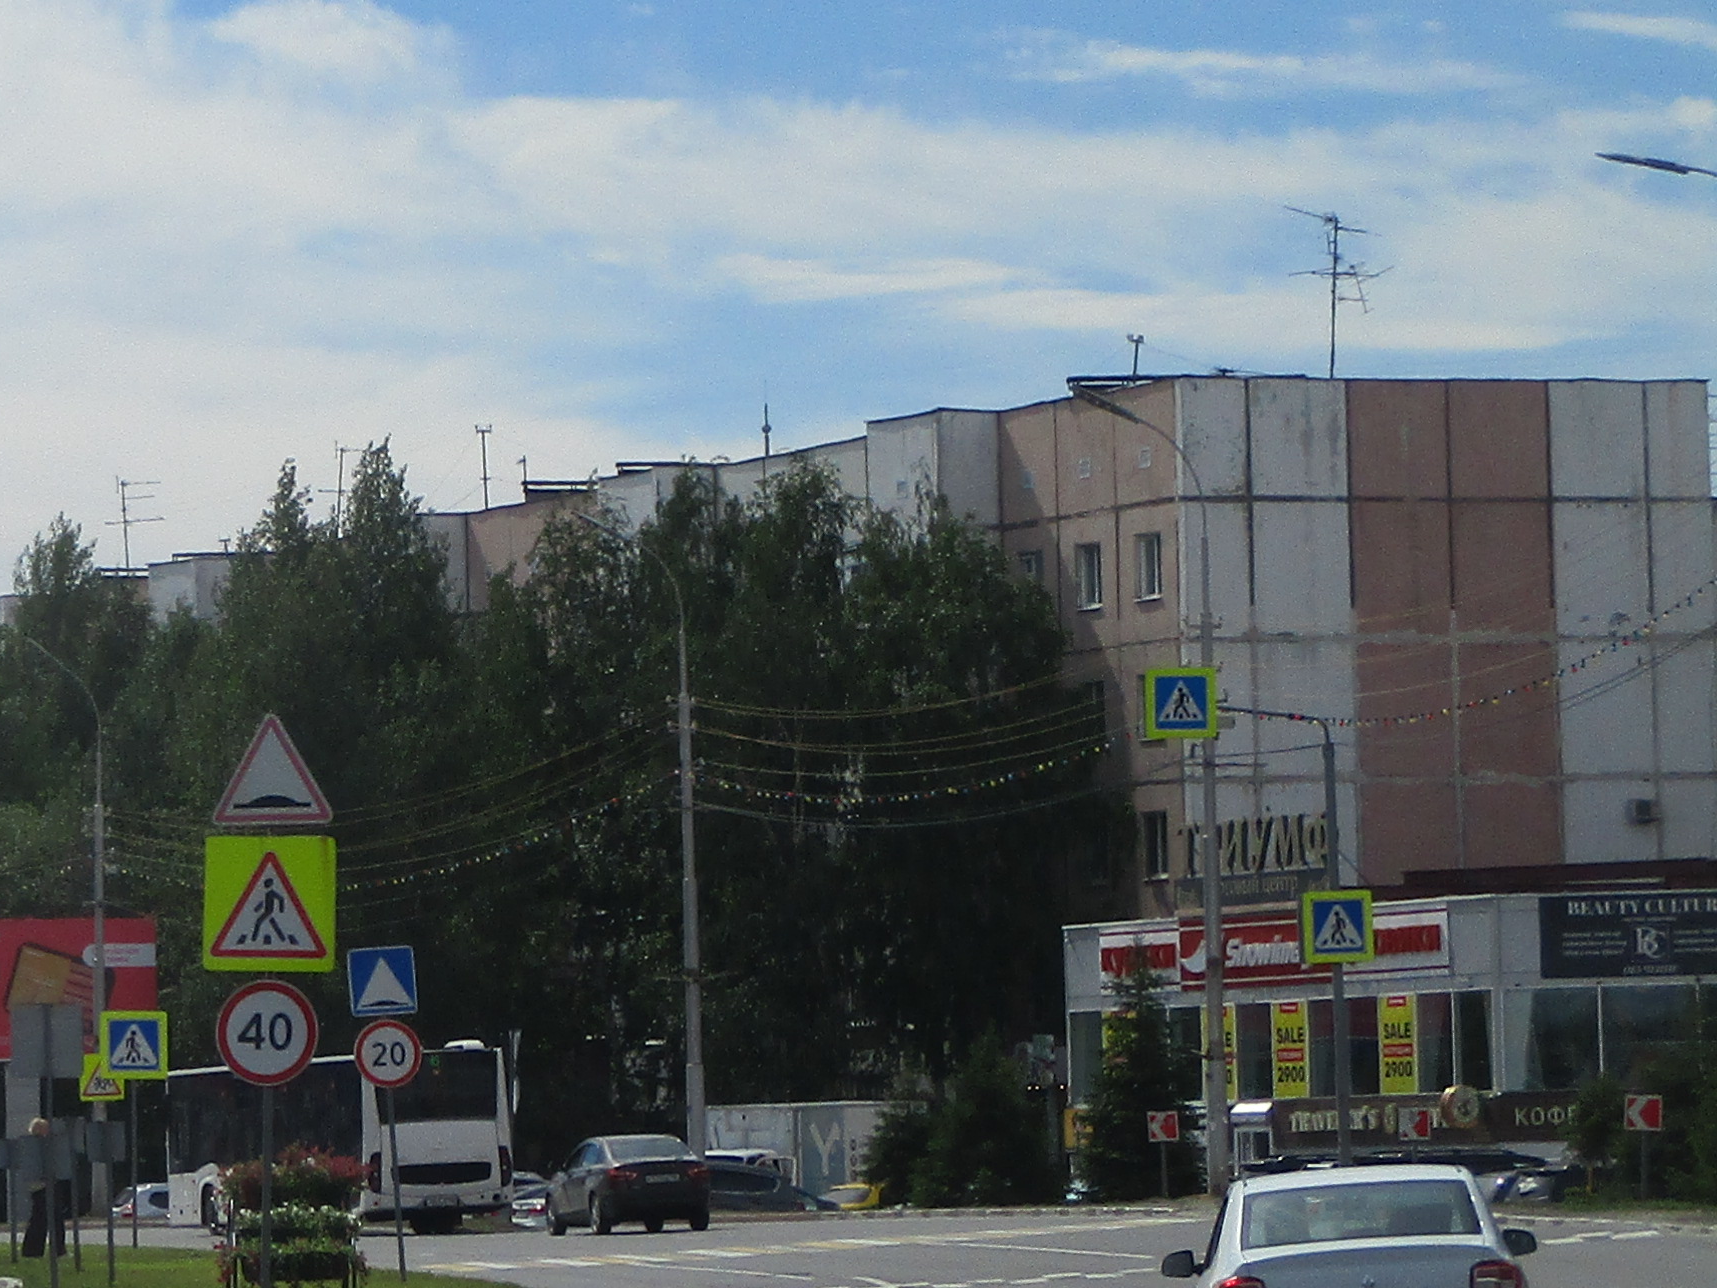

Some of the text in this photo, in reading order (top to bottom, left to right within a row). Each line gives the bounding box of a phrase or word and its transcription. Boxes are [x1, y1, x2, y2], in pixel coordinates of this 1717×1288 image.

[1176, 813, 1331, 880] ТИУМФ
[1567, 899, 1641, 915] BEAUTY
[237, 1011, 293, 1052] 40
[1276, 1026, 1306, 1044] SALE
[1383, 1022, 1412, 1040] SALE
[371, 1040, 407, 1067] 20
[1277, 1066, 1306, 1083] 2900
[1384, 1061, 1413, 1078] 2900
